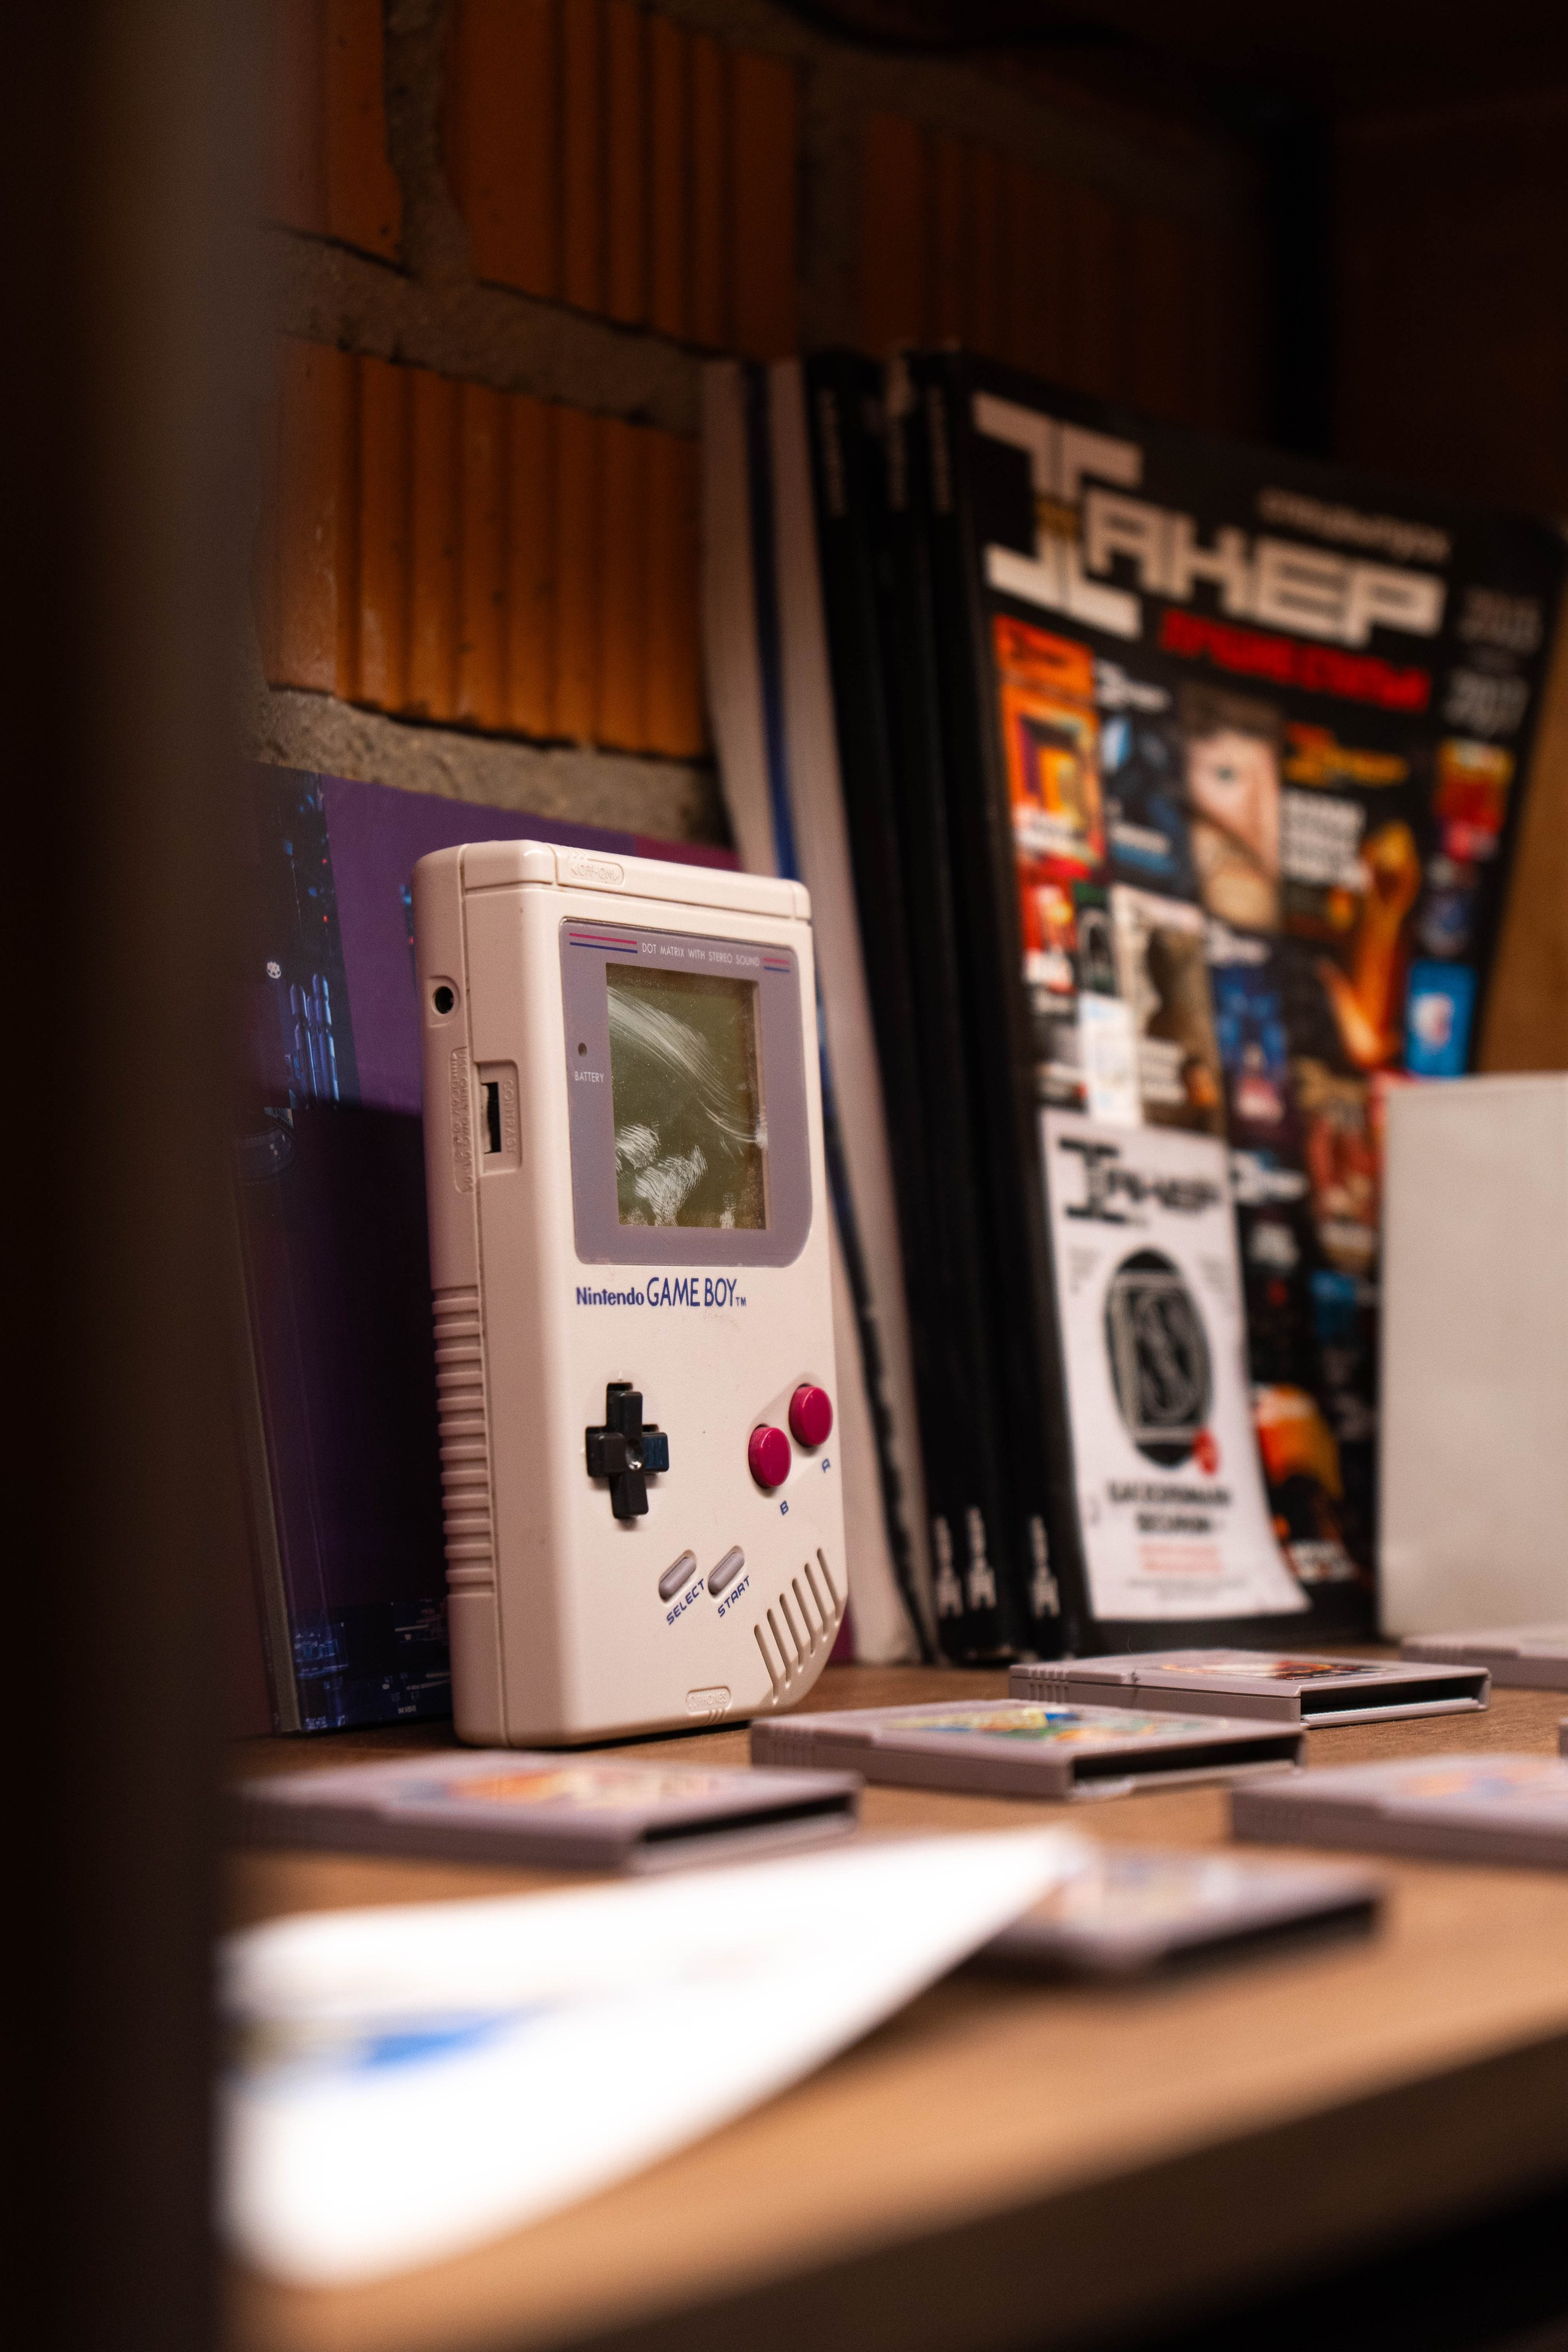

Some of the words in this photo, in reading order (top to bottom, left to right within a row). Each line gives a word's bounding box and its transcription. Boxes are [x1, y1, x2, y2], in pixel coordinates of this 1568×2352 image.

[642, 943, 657, 954] DOT
[660, 946, 685, 957] MATRIX
[688, 949, 705, 960] WITH
[709, 951, 733, 963] STEREO
[735, 954, 761, 967] SOUND
[574, 1071, 605, 1083] BATTERY
[576, 1287, 644, 1305] Nintendo
[647, 1277, 700, 1306] GAME
[704, 1278, 737, 1306] BOY
[821, 1458, 831, 1473] A
[779, 1500, 790, 1516] B
[666, 1578, 705, 1626] SELECT
[717, 1575, 750, 1618] START
[696, 1691, 727, 1705] PHONES
